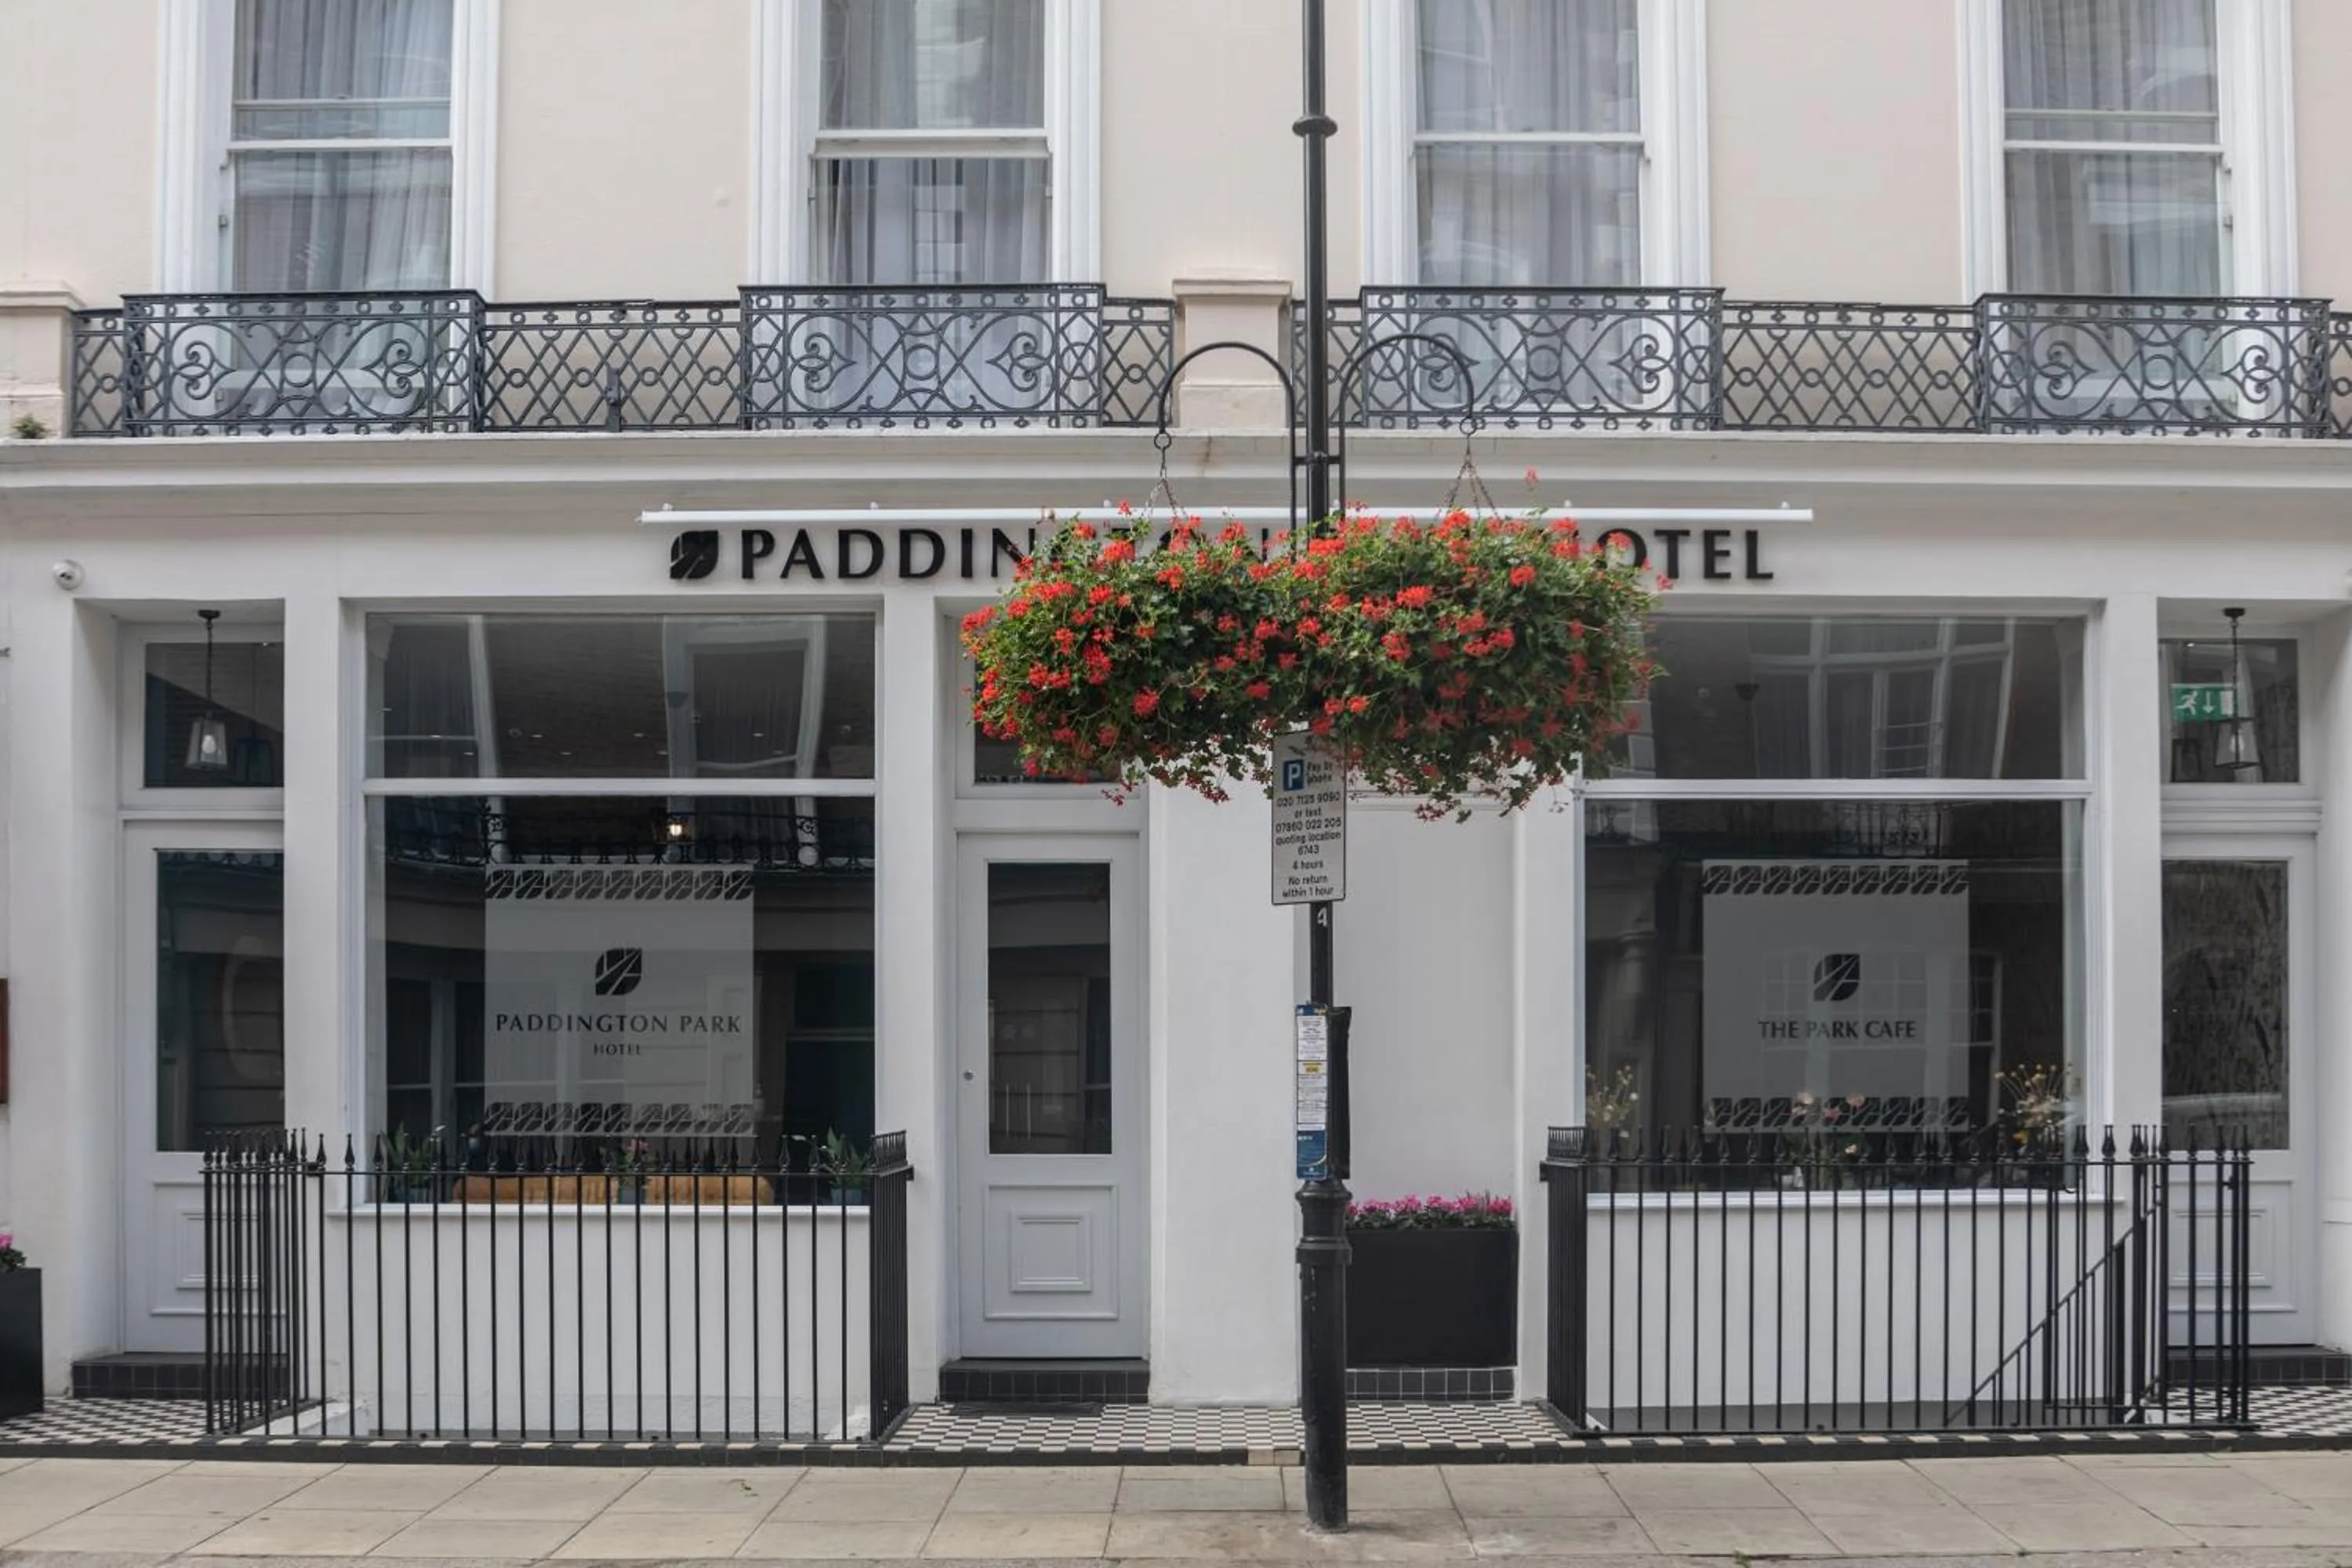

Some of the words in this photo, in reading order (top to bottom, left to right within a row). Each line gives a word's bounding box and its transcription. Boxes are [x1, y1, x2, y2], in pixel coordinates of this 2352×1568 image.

[741, 527, 1269, 580] PADDIN
[1535, 527, 1774, 579] OTEL
[1307, 761, 1321, 774] Pay
[1277, 797, 1294, 807] 020
[1297, 794, 1315, 805] 7125
[1305, 807, 1321, 816] text
[1305, 818, 1321, 829] 022
[1276, 834, 1305, 845] quoting
[1308, 831, 1341, 841] location
[1298, 844, 1319, 855] 6743
[1293, 860, 1298, 869] 4
[1301, 859, 1323, 869] hours
[1288, 876, 1300, 885] No
[1303, 874, 1327, 884] return
[1283, 886, 1306, 897] within
[1309, 887, 1313, 895] 1
[1316, 886, 1334, 895] hour
[1317, 906, 1327, 927] 4
[495, 1014, 667, 1033] PADDINGTON
[681, 1015, 741, 1033] PARK
[1758, 1021, 1798, 1039] THE
[1806, 1021, 1858, 1039] PARK
[1864, 1020, 1917, 1039] CAFE
[593, 1044, 641, 1056] HOTEL
